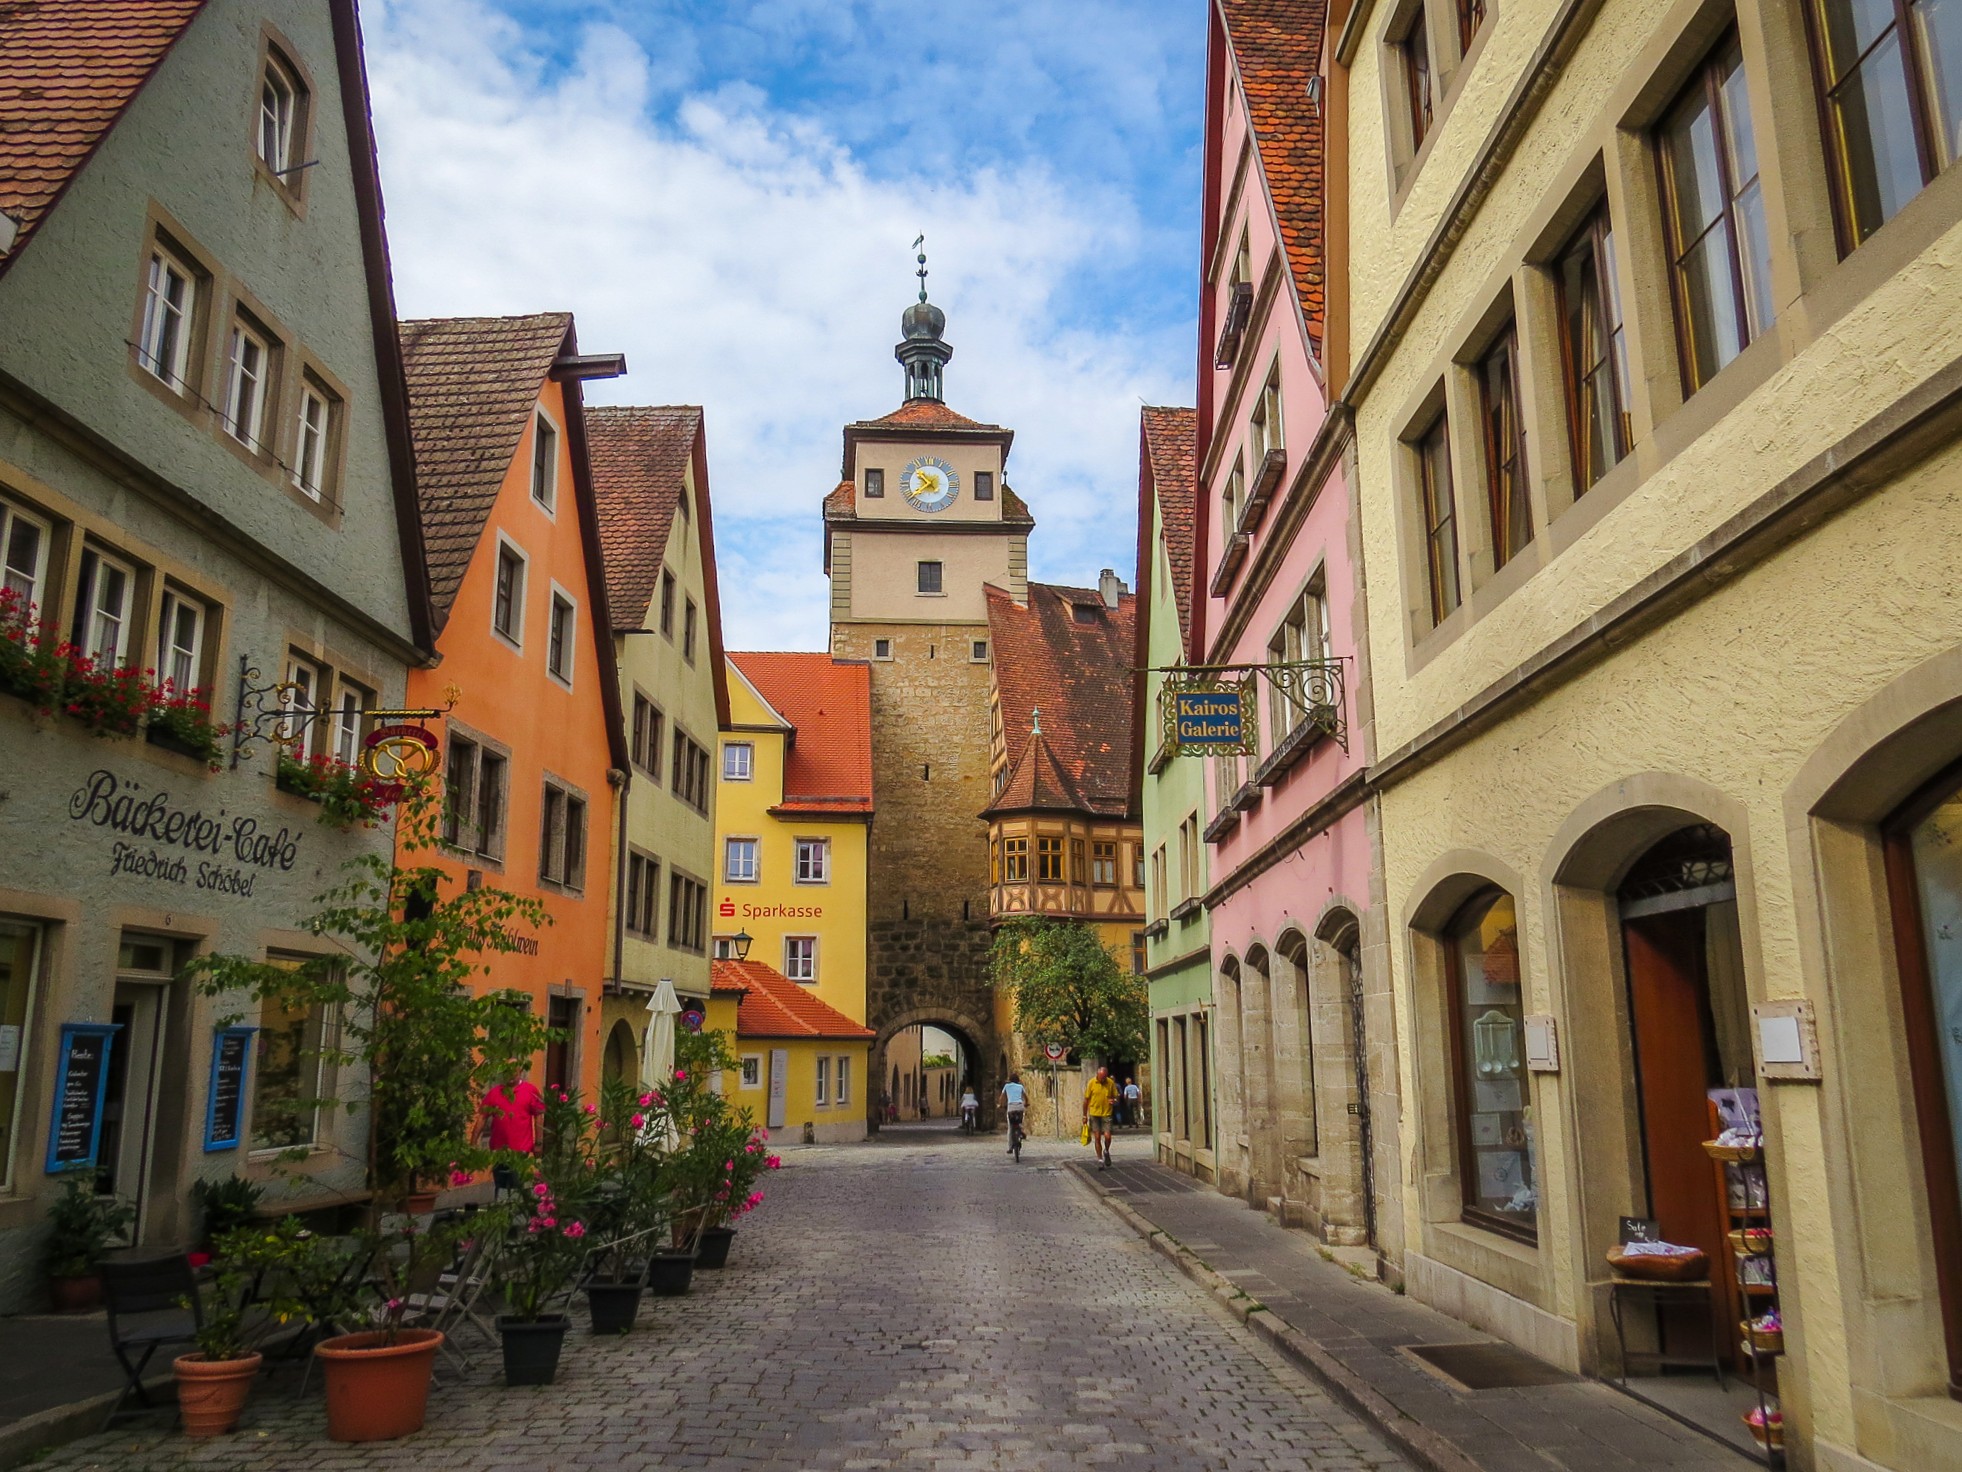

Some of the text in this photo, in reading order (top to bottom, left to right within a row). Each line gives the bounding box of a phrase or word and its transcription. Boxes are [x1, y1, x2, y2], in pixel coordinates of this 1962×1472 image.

[1180, 699, 1238, 716] Kairos
[1180, 721, 1239, 737] Galerie
[69, 769, 303, 871] Bäckerei-Café
[110, 841, 257, 898] Friedrich Schöbel
[742, 903, 823, 921] Sparkasse
